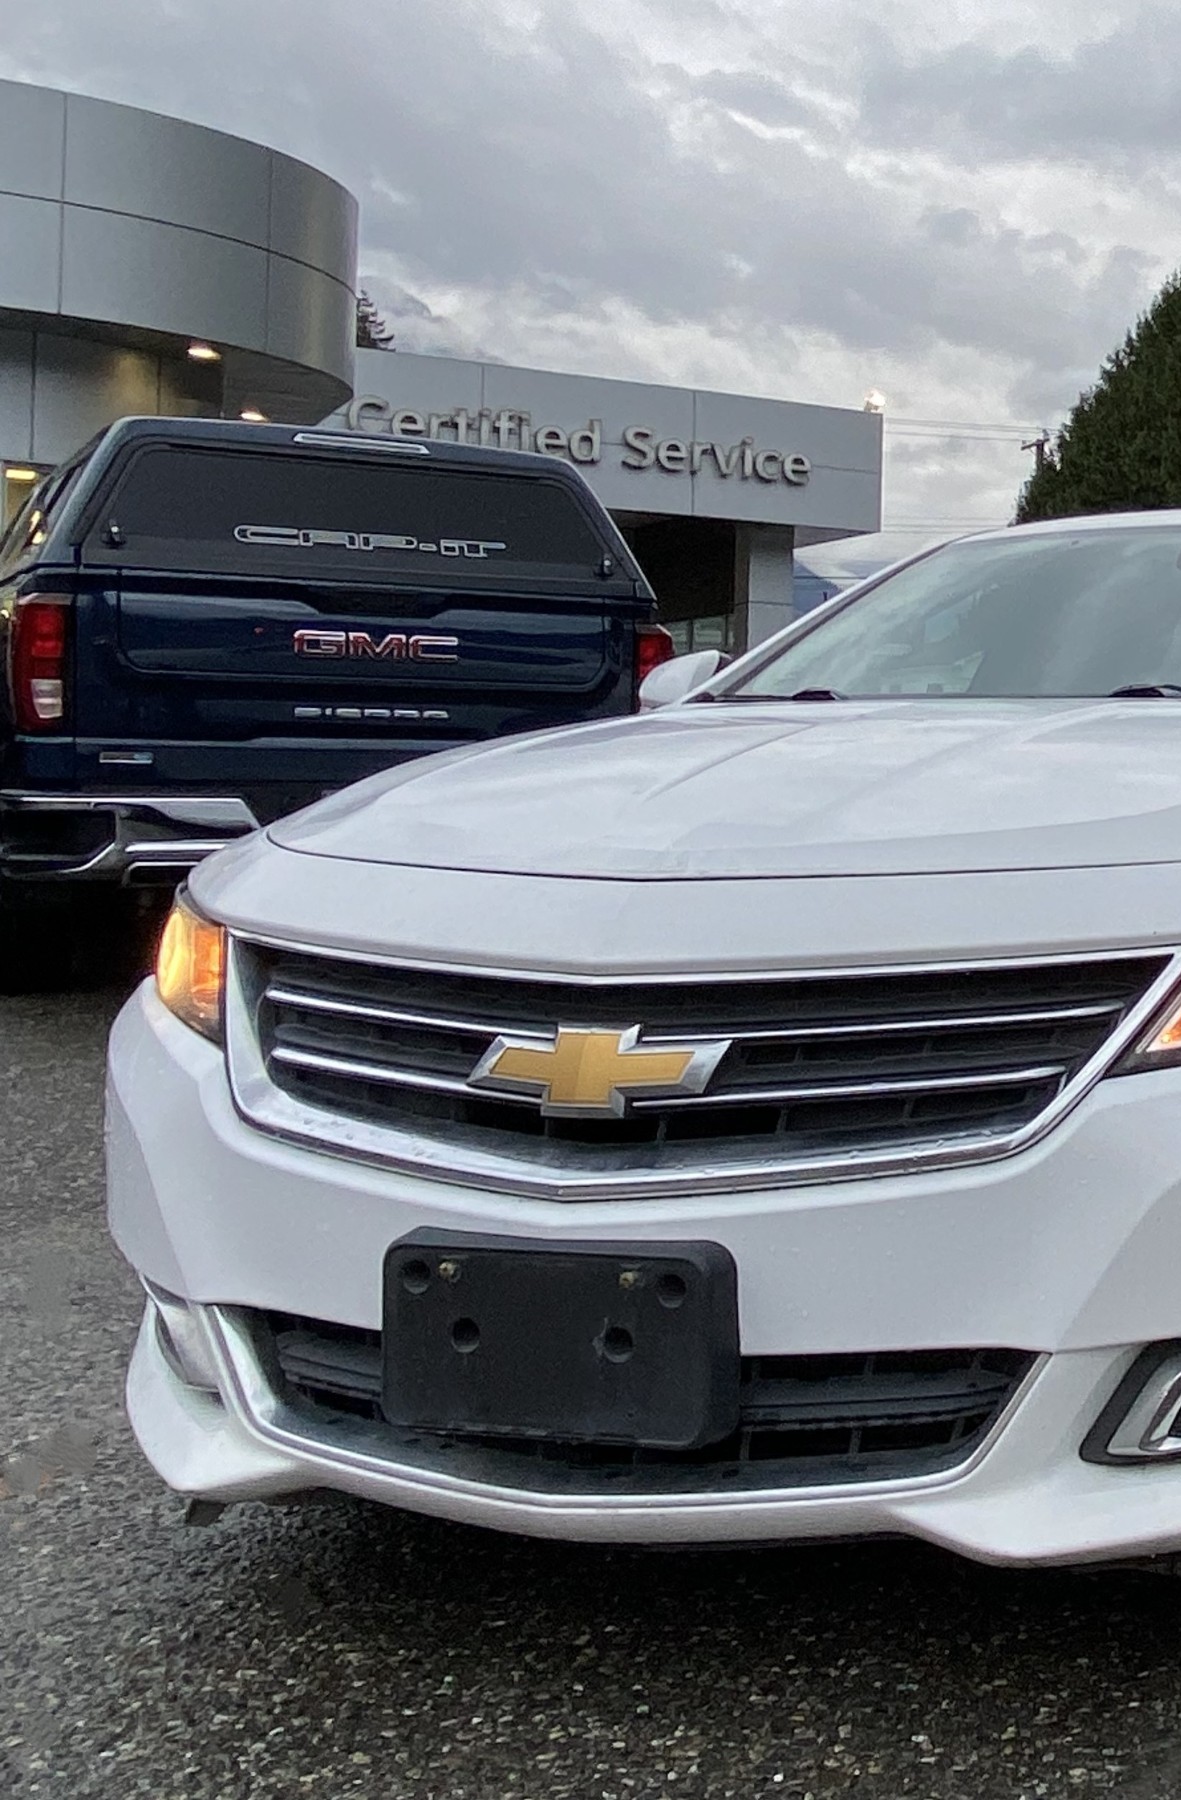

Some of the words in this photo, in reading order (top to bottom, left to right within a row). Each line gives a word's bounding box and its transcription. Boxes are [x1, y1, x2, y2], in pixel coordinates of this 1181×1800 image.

[347, 394, 603, 465] Certified
[620, 424, 813, 487] Service
[292, 629, 460, 664] GMC
